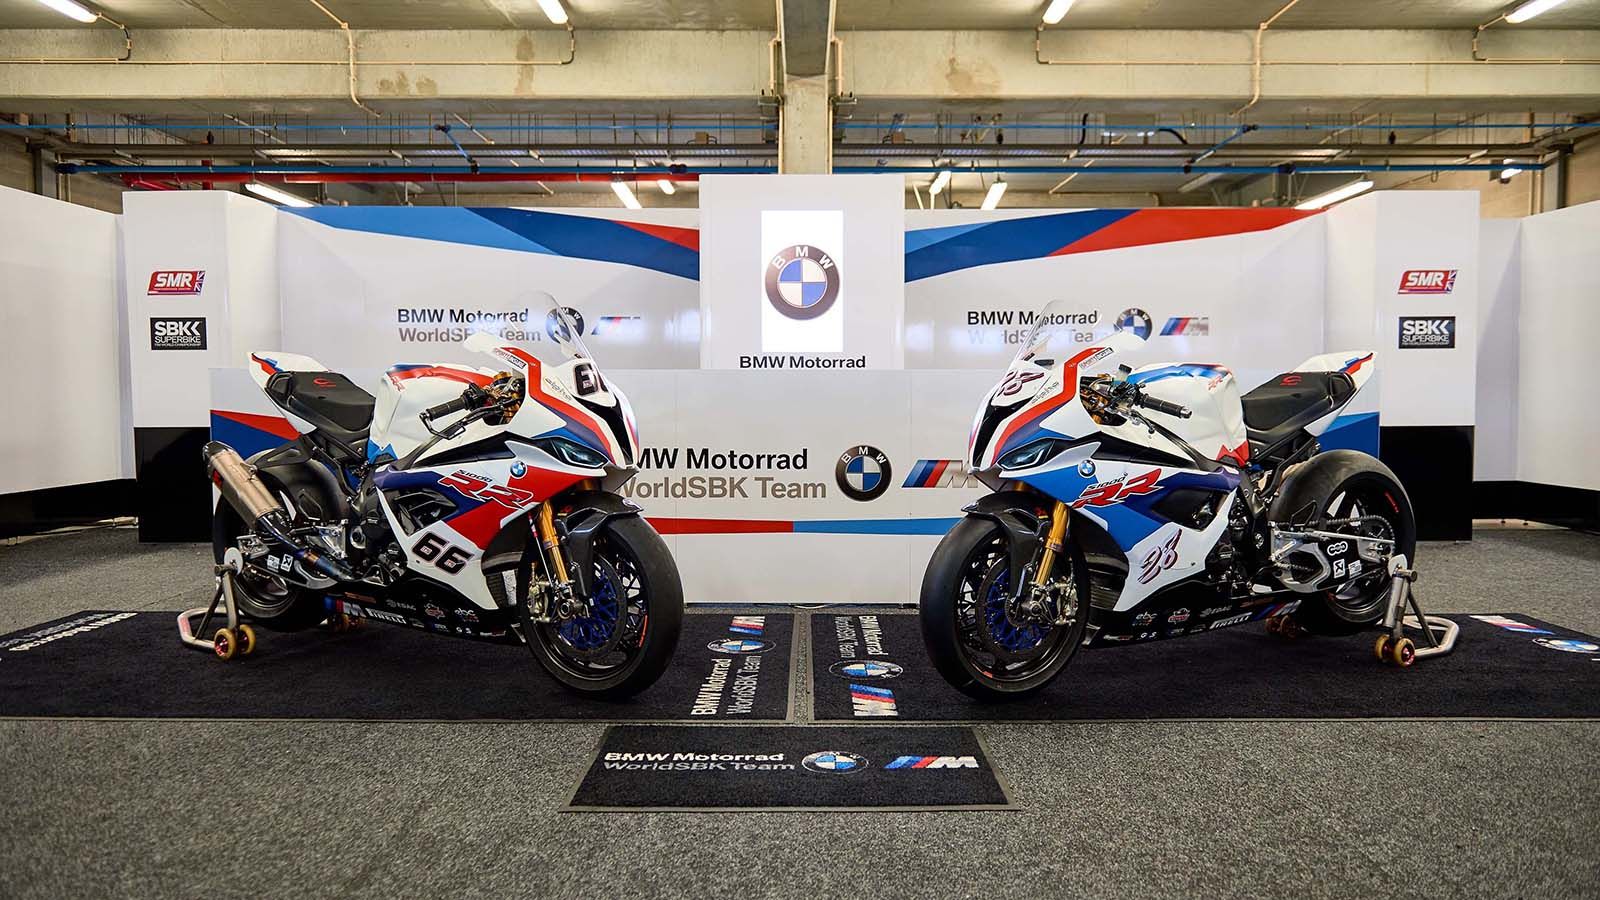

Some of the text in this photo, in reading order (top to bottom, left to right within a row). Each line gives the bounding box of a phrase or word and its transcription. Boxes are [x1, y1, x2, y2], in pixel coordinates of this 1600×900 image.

[771, 246, 834, 270] BMW
[154, 272, 193, 288] SMR
[1405, 271, 1445, 287] SMR
[397, 308, 529, 323] BMW Motorrad
[967, 310, 1098, 326] BMW Motorrad
[154, 335, 201, 343] SUPERBIKE
[1402, 334, 1450, 343] SUPERBIKE
[739, 355, 866, 369] BMW Motorrad
[637, 447, 808, 470] MW Motorrad
[841, 446, 887, 464] BMW
[438, 471, 534, 511] RR
[754, 476, 827, 499] Team
[1072, 468, 1165, 510] RR
[412, 531, 475, 575] 66
[365, 607, 407, 625] PIRELLI
[1209, 612, 1253, 630] PIRELLI
[701, 658, 733, 692] Motorrad
[727, 655, 762, 714] WorldSBK Team
[691, 692, 722, 715] BMW
[604, 752, 785, 762] BMW Motorrad
[604, 761, 796, 771] WorldSBK Team
